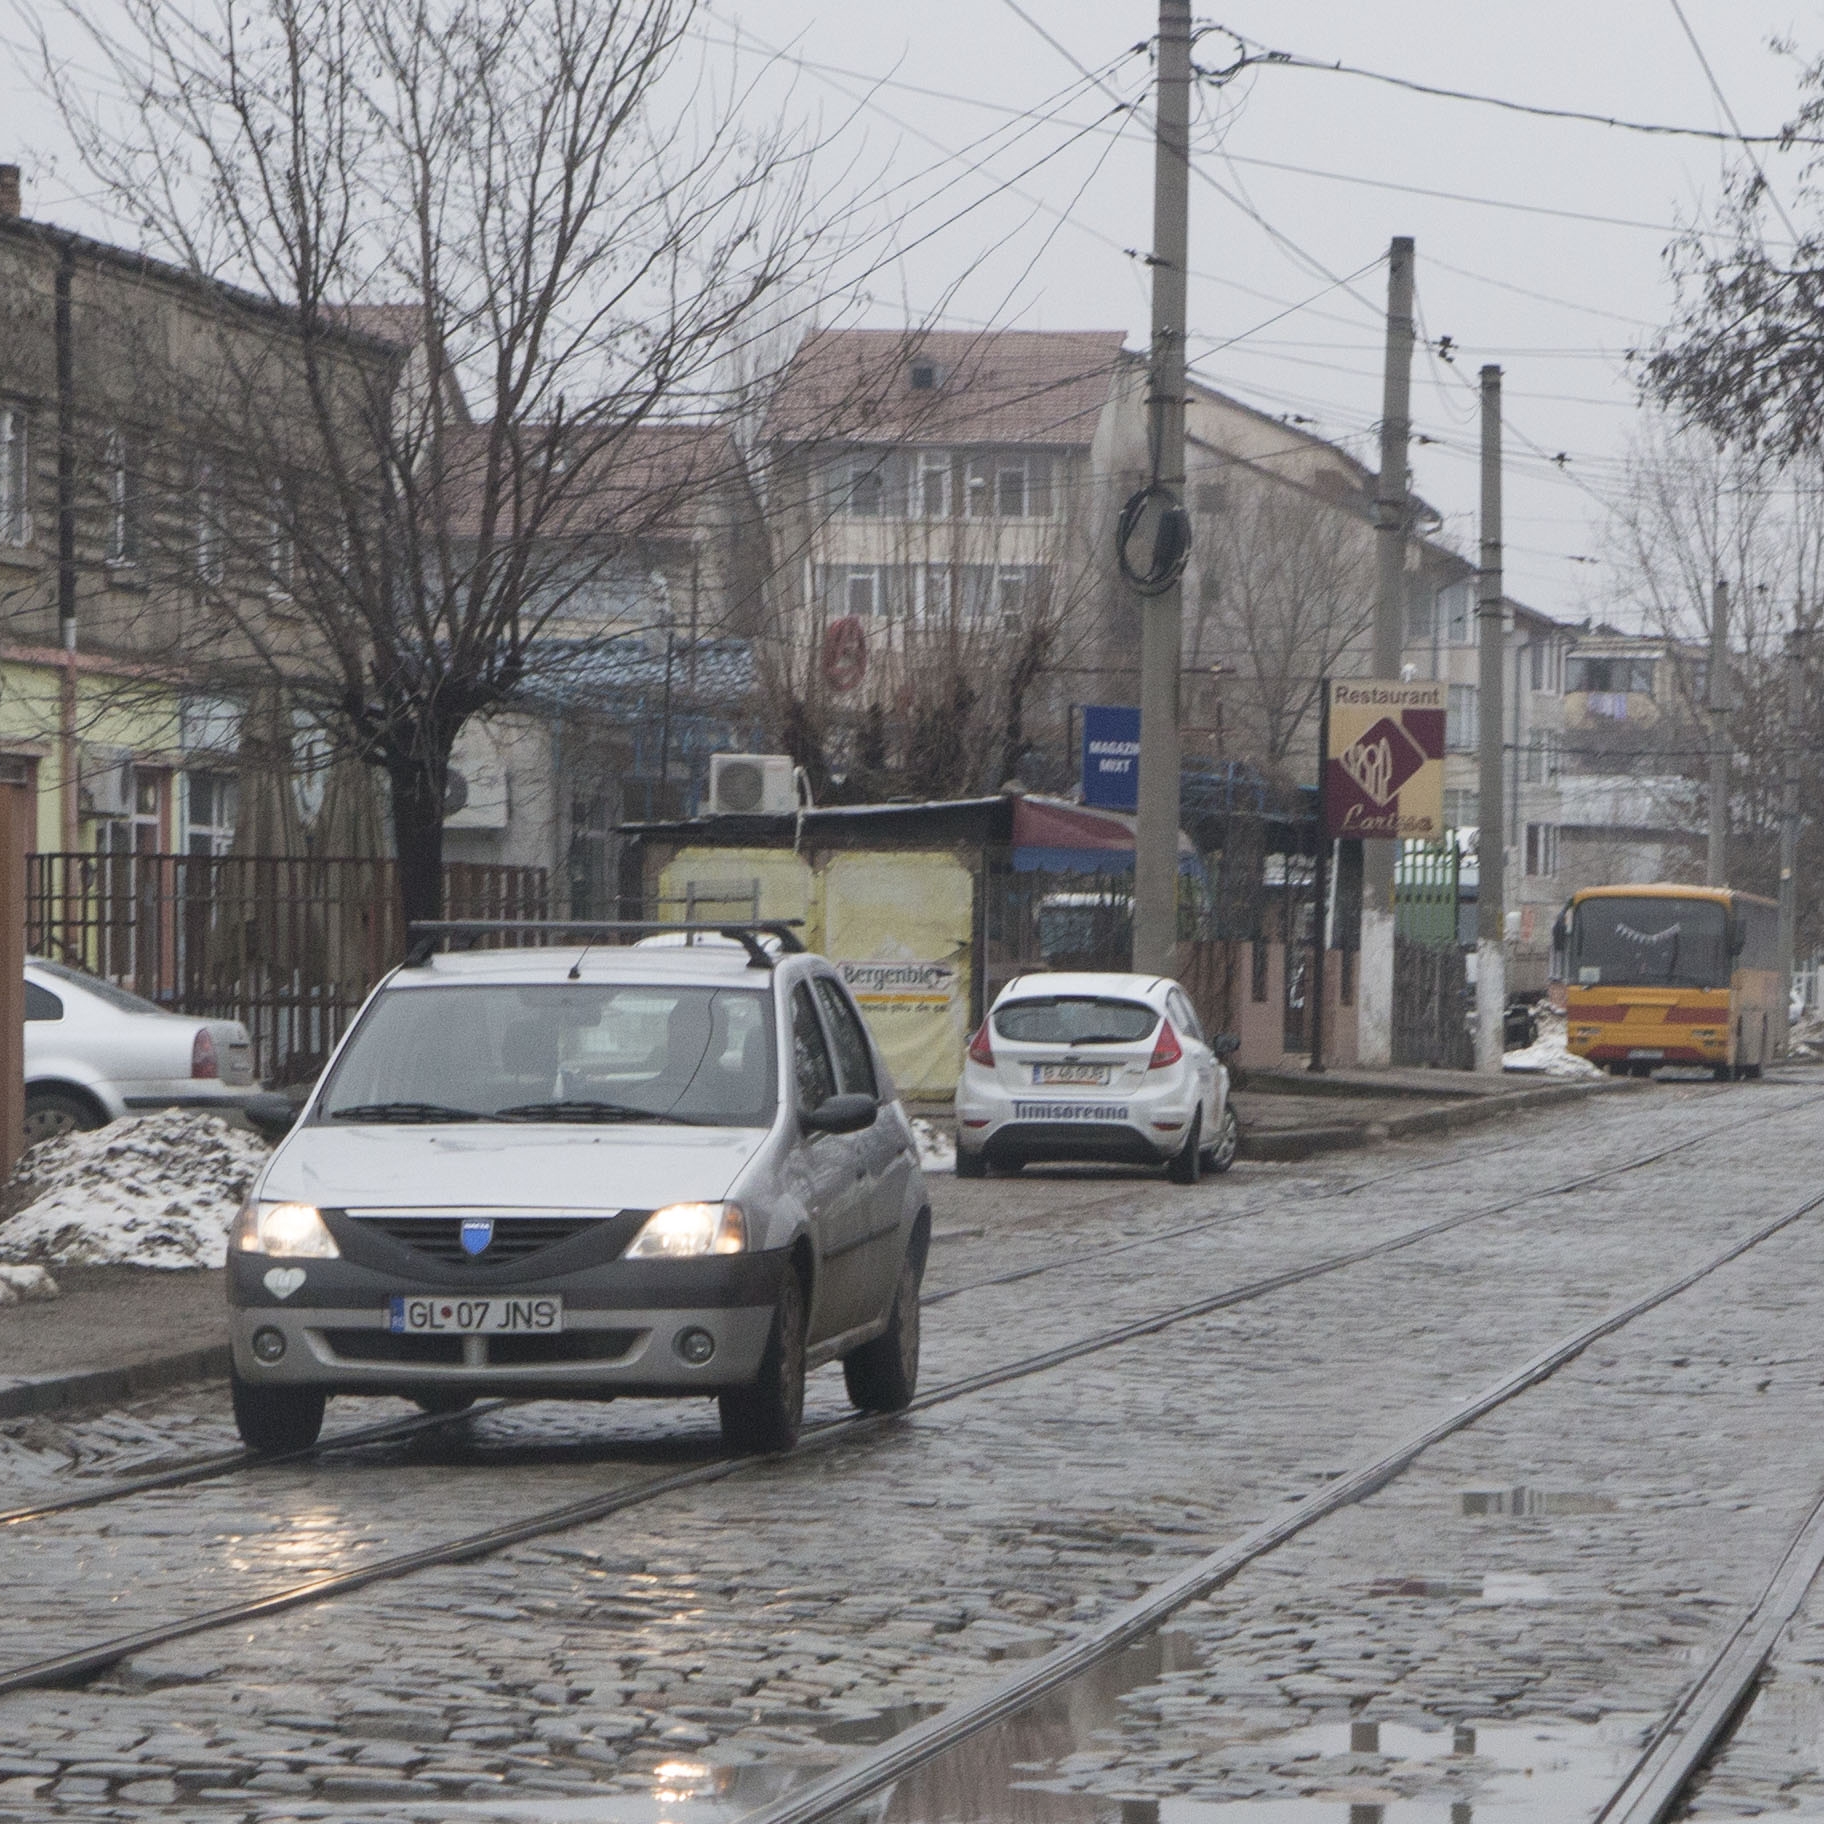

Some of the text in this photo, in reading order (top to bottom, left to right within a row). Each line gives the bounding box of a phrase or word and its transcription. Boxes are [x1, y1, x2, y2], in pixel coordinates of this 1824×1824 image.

[1335, 685, 1441, 705] Restaurant
[1099, 759, 1131, 774] MIXT
[409, 1301, 445, 1329] GL
[457, 1301, 490, 1329] 07
[496, 1301, 555, 1329] JNS
